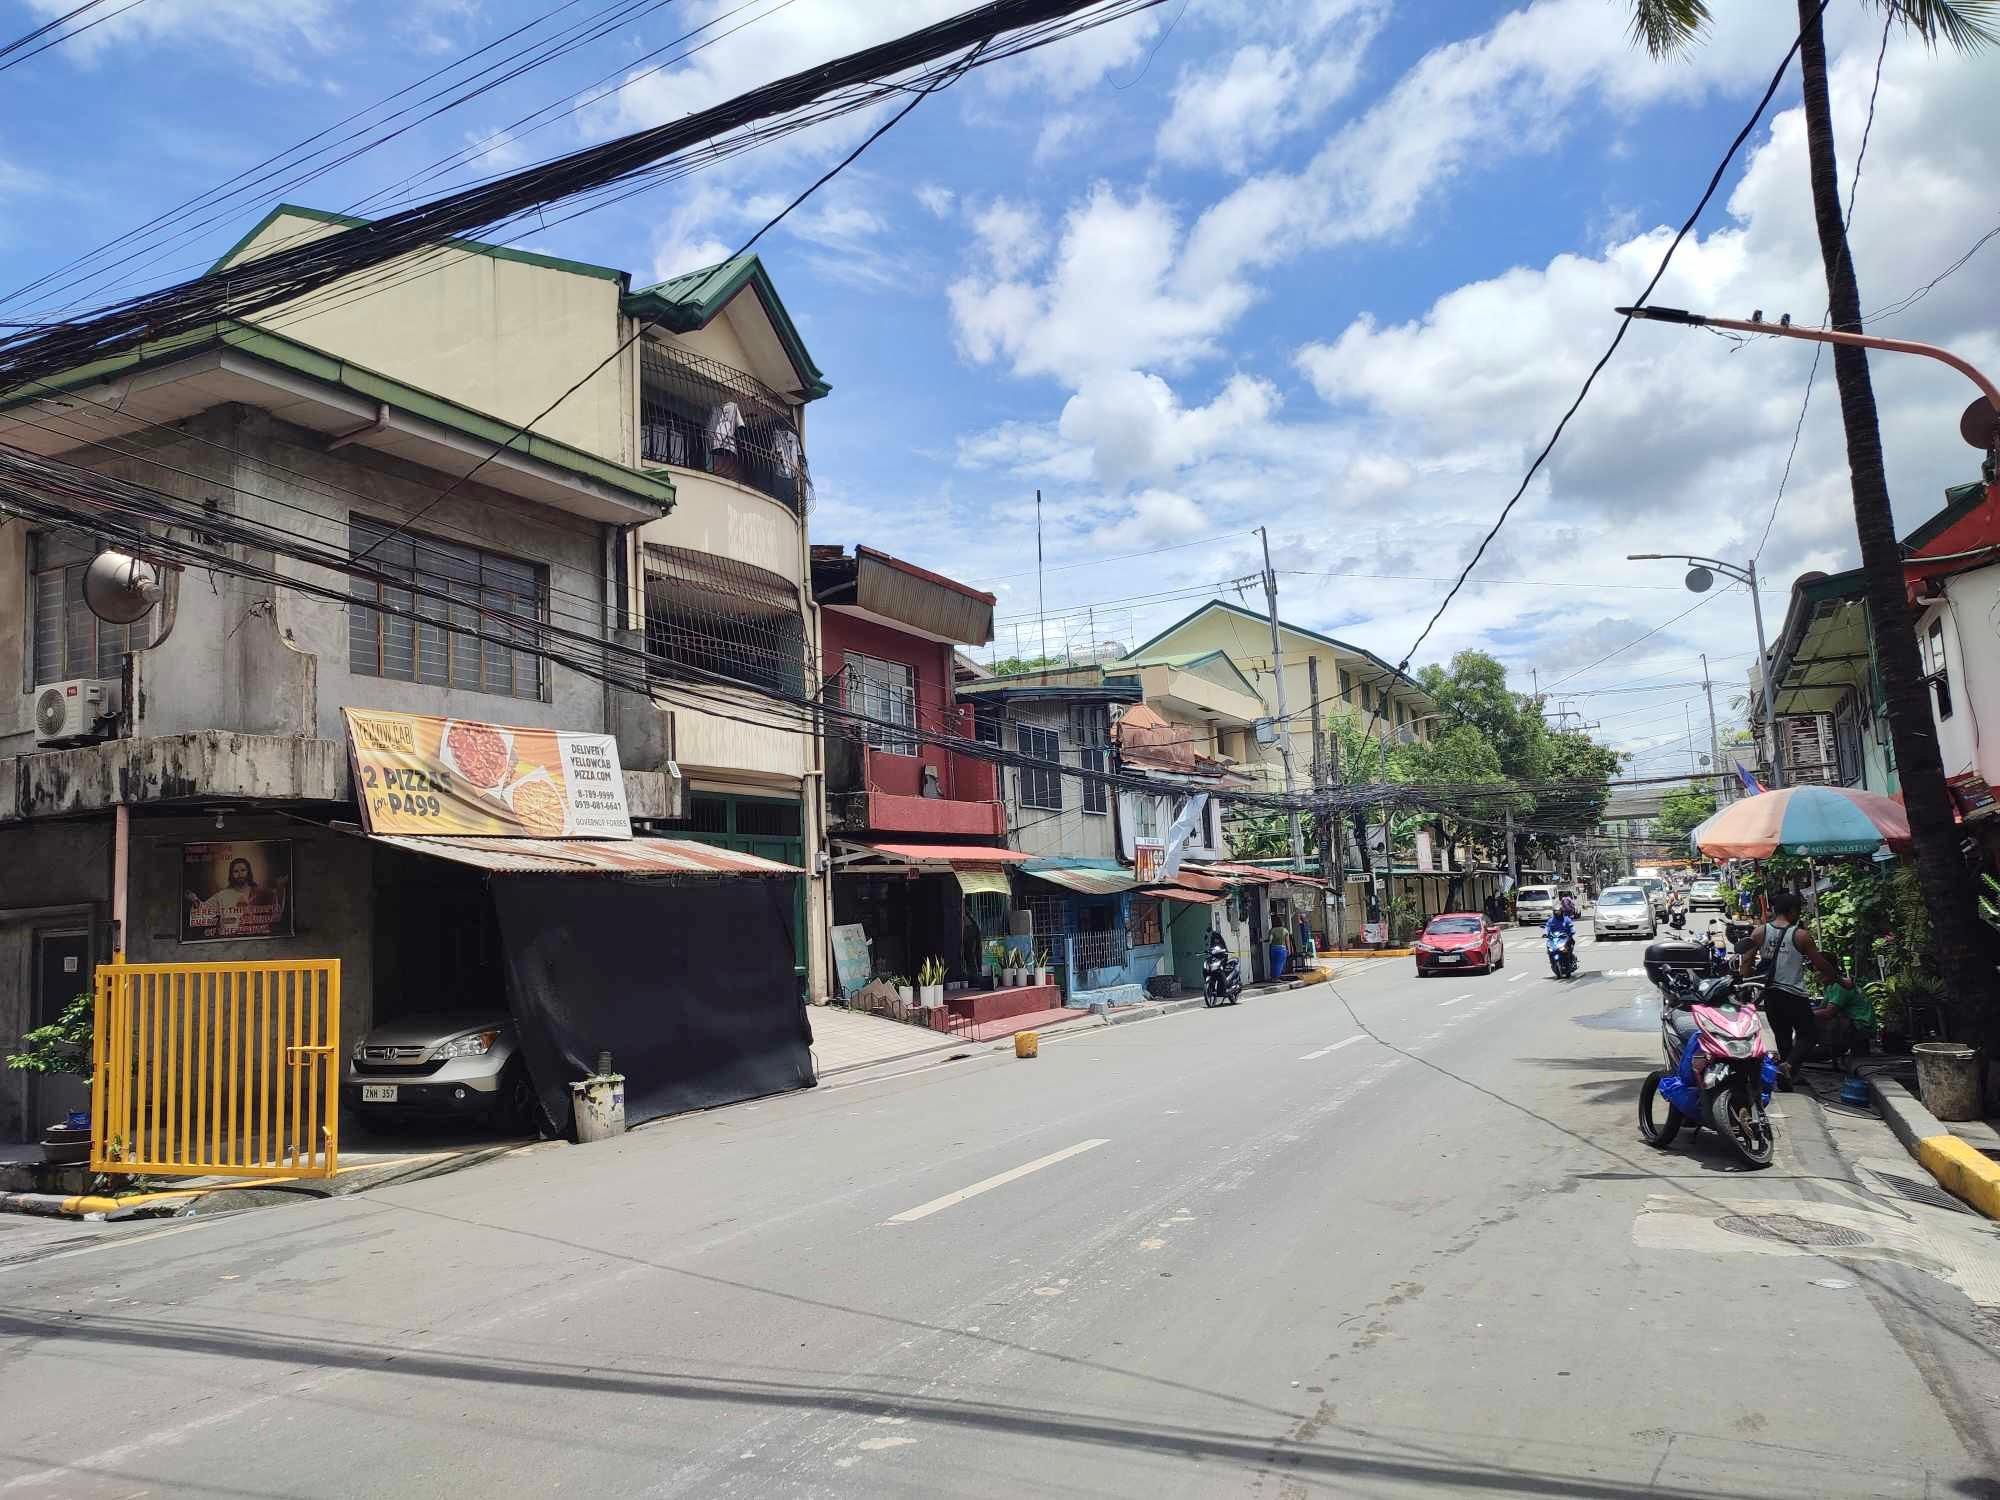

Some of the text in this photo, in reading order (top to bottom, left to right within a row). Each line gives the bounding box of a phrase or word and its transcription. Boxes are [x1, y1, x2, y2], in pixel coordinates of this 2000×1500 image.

[355, 719, 412, 745] YELLOW CAB
[570, 757, 611, 769] YELLOWCAB
[363, 765, 453, 793] 2 PIZZAS
[574, 770, 612, 782] PIZZA.COM
[373, 797, 388, 818] for
[382, 1088, 394, 1098] 357
